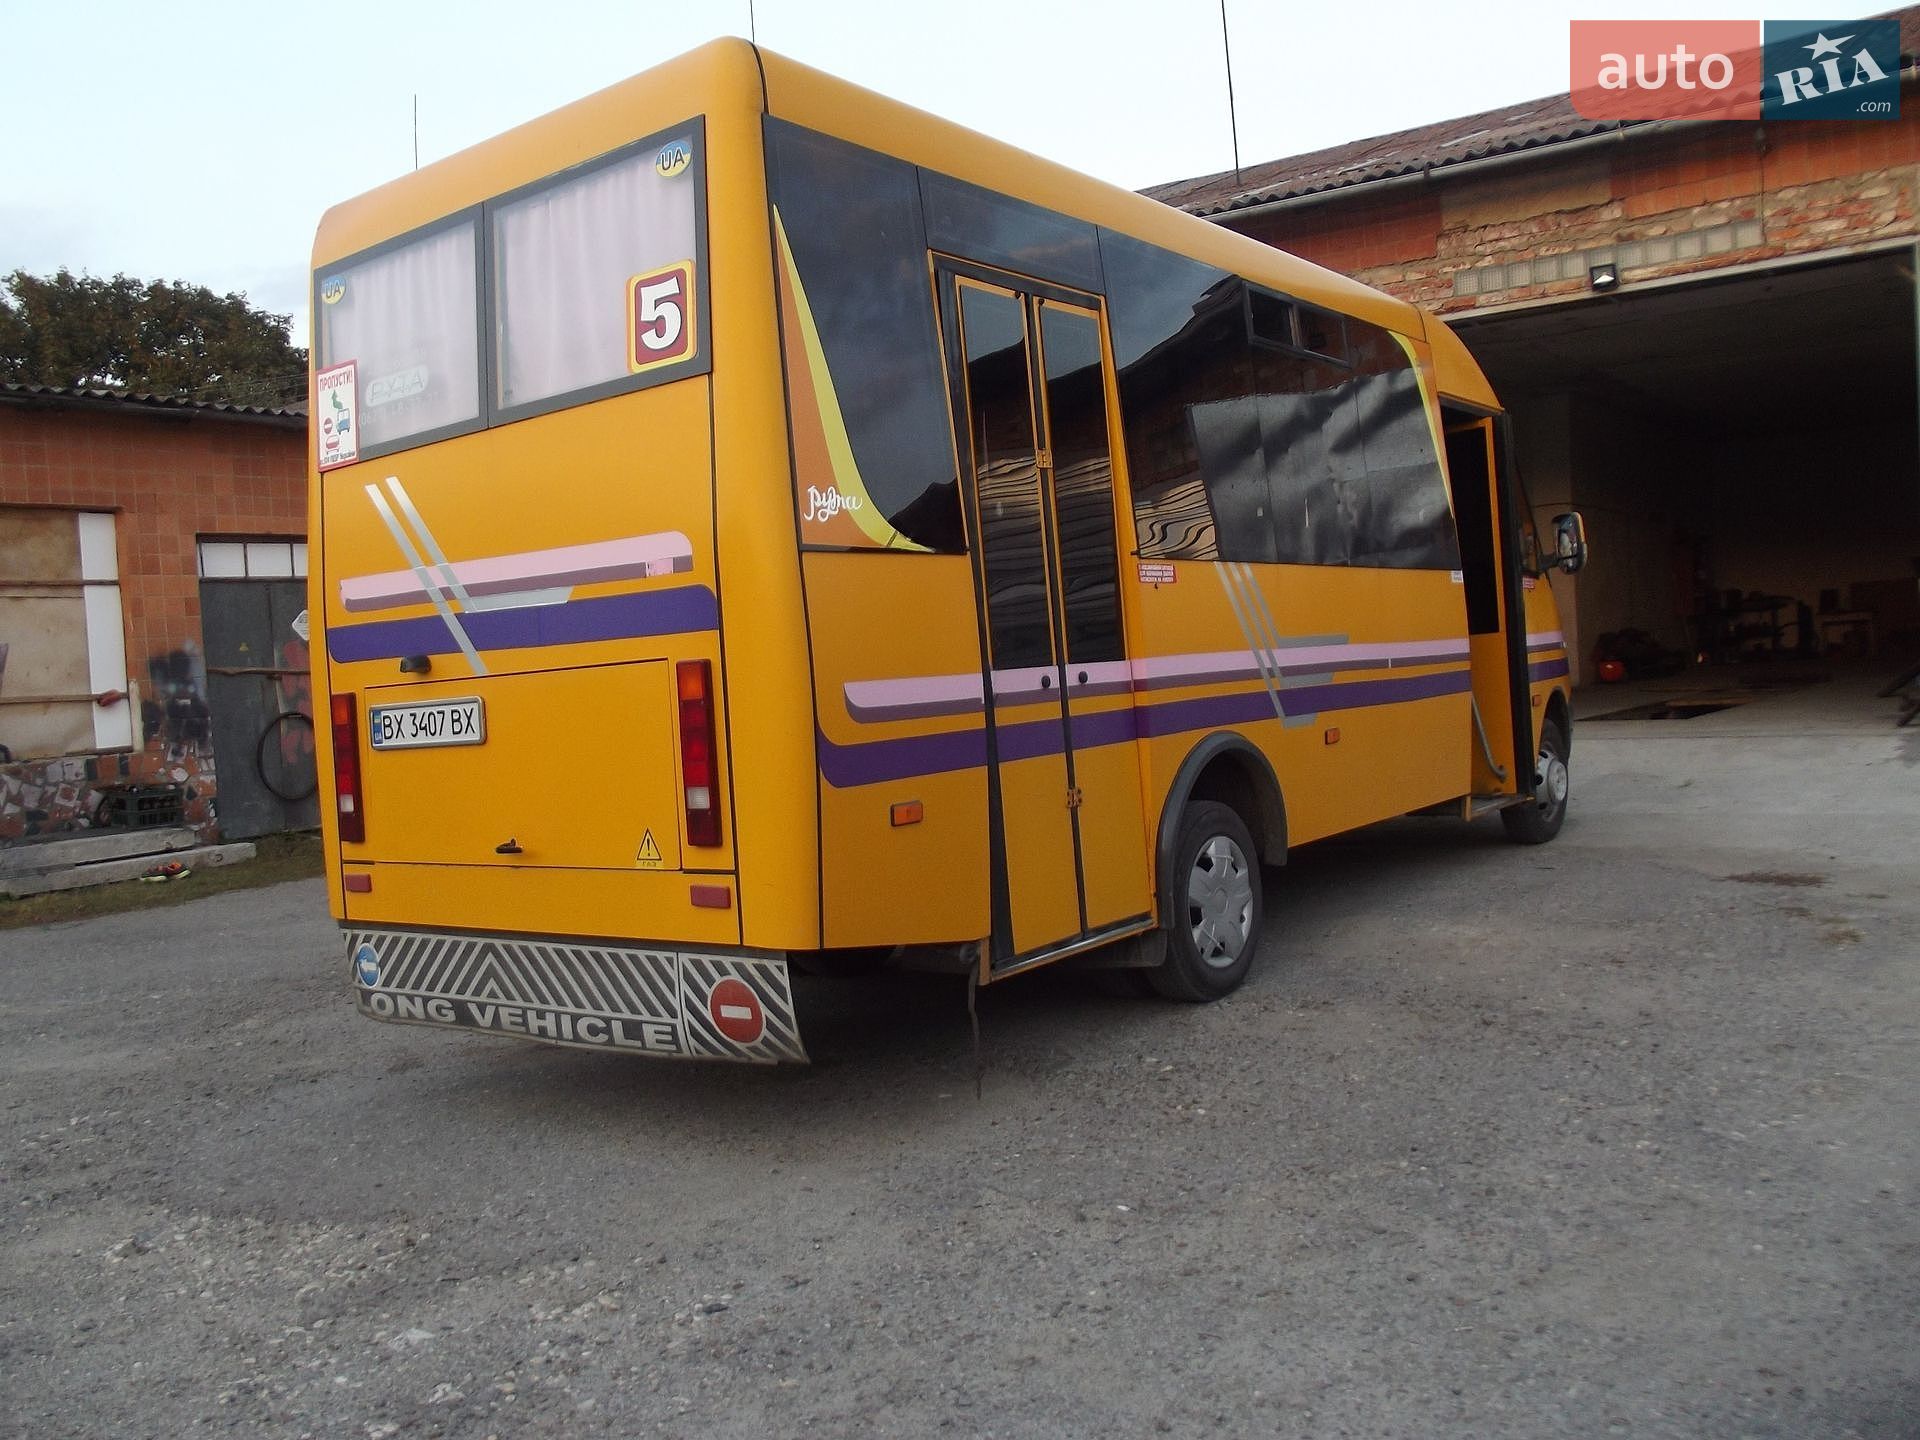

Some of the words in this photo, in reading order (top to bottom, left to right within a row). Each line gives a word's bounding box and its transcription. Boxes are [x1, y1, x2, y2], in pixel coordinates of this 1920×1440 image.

[660, 146, 685, 171] UA
[326, 280, 342, 299] UA
[640, 276, 682, 350] 5
[319, 369, 353, 392] ПРОПУСТИ!
[382, 714, 405, 740] BX
[409, 709, 445, 738] 3407
[450, 707, 476, 736] BX
[468, 1002, 678, 1051] VEHICLE
